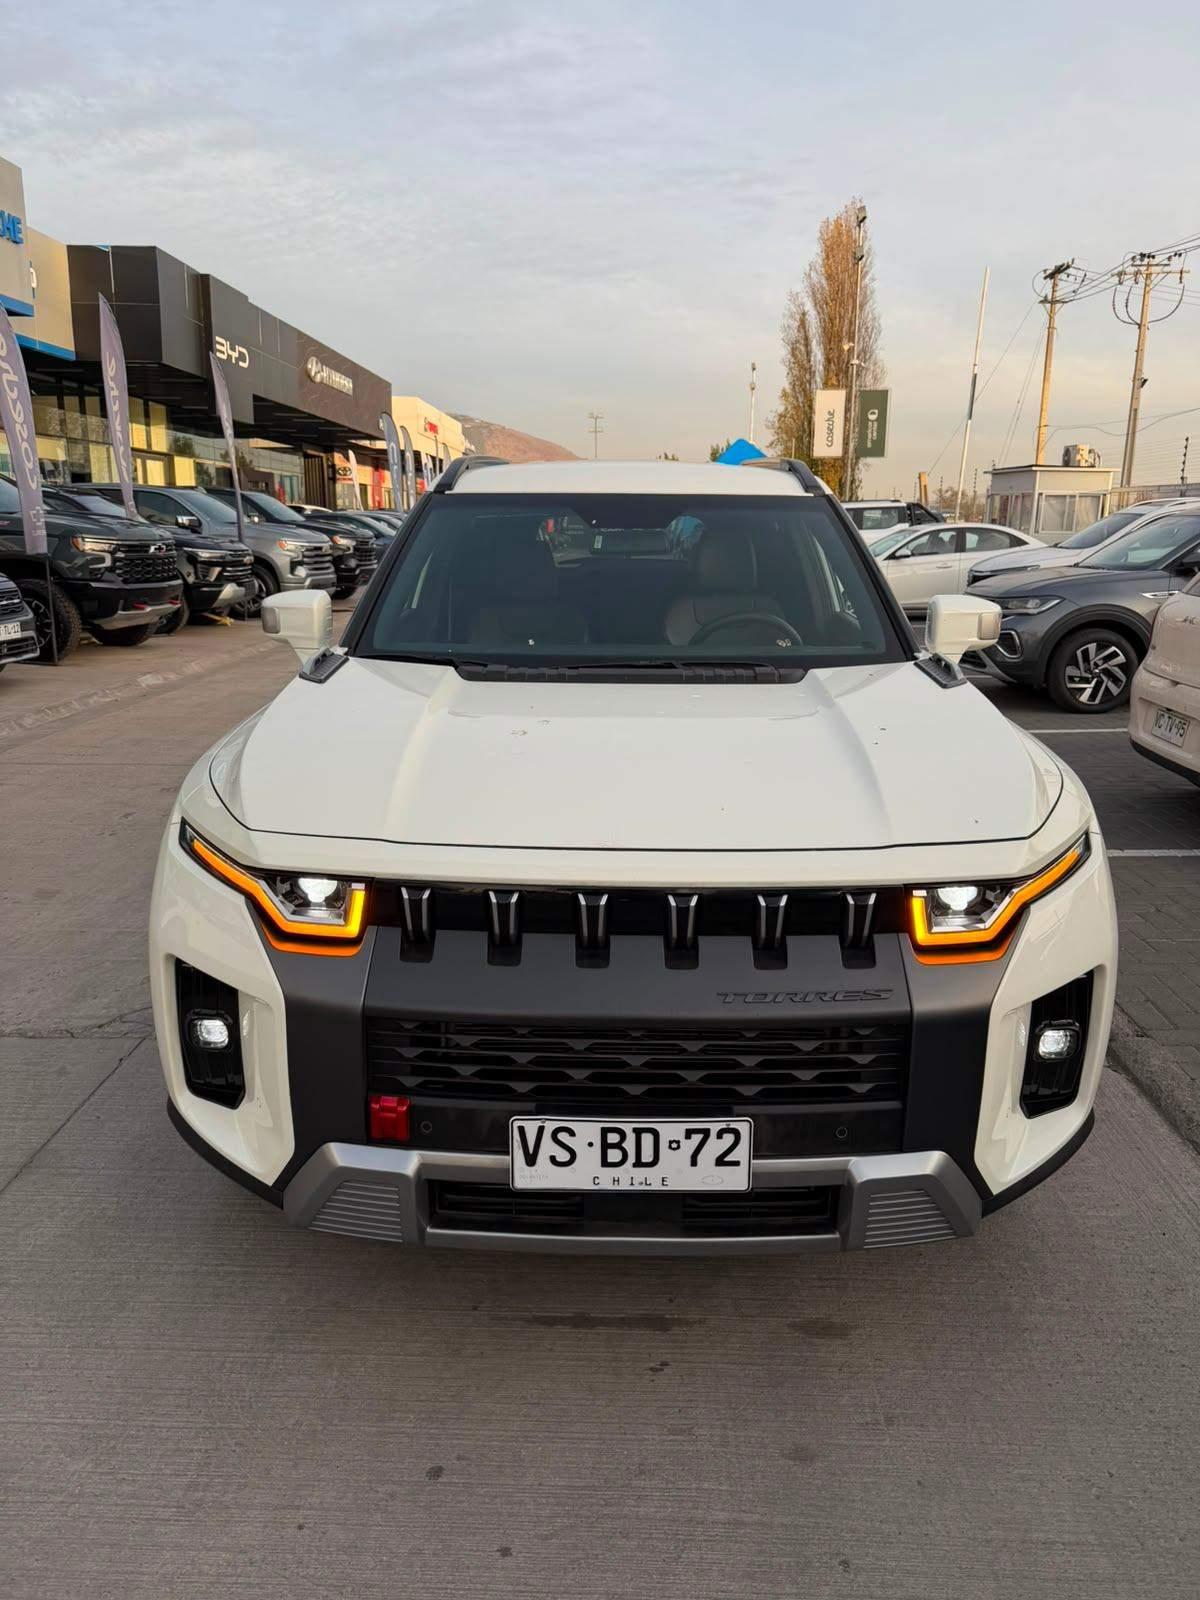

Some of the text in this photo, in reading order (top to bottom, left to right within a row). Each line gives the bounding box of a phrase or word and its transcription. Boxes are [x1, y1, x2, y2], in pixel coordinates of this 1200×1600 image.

[0, 210, 24, 244] HE
[215, 335, 249, 368] BYD
[716, 989, 894, 1004] TORRES
[592, 1176, 669, 1187] CHILE
